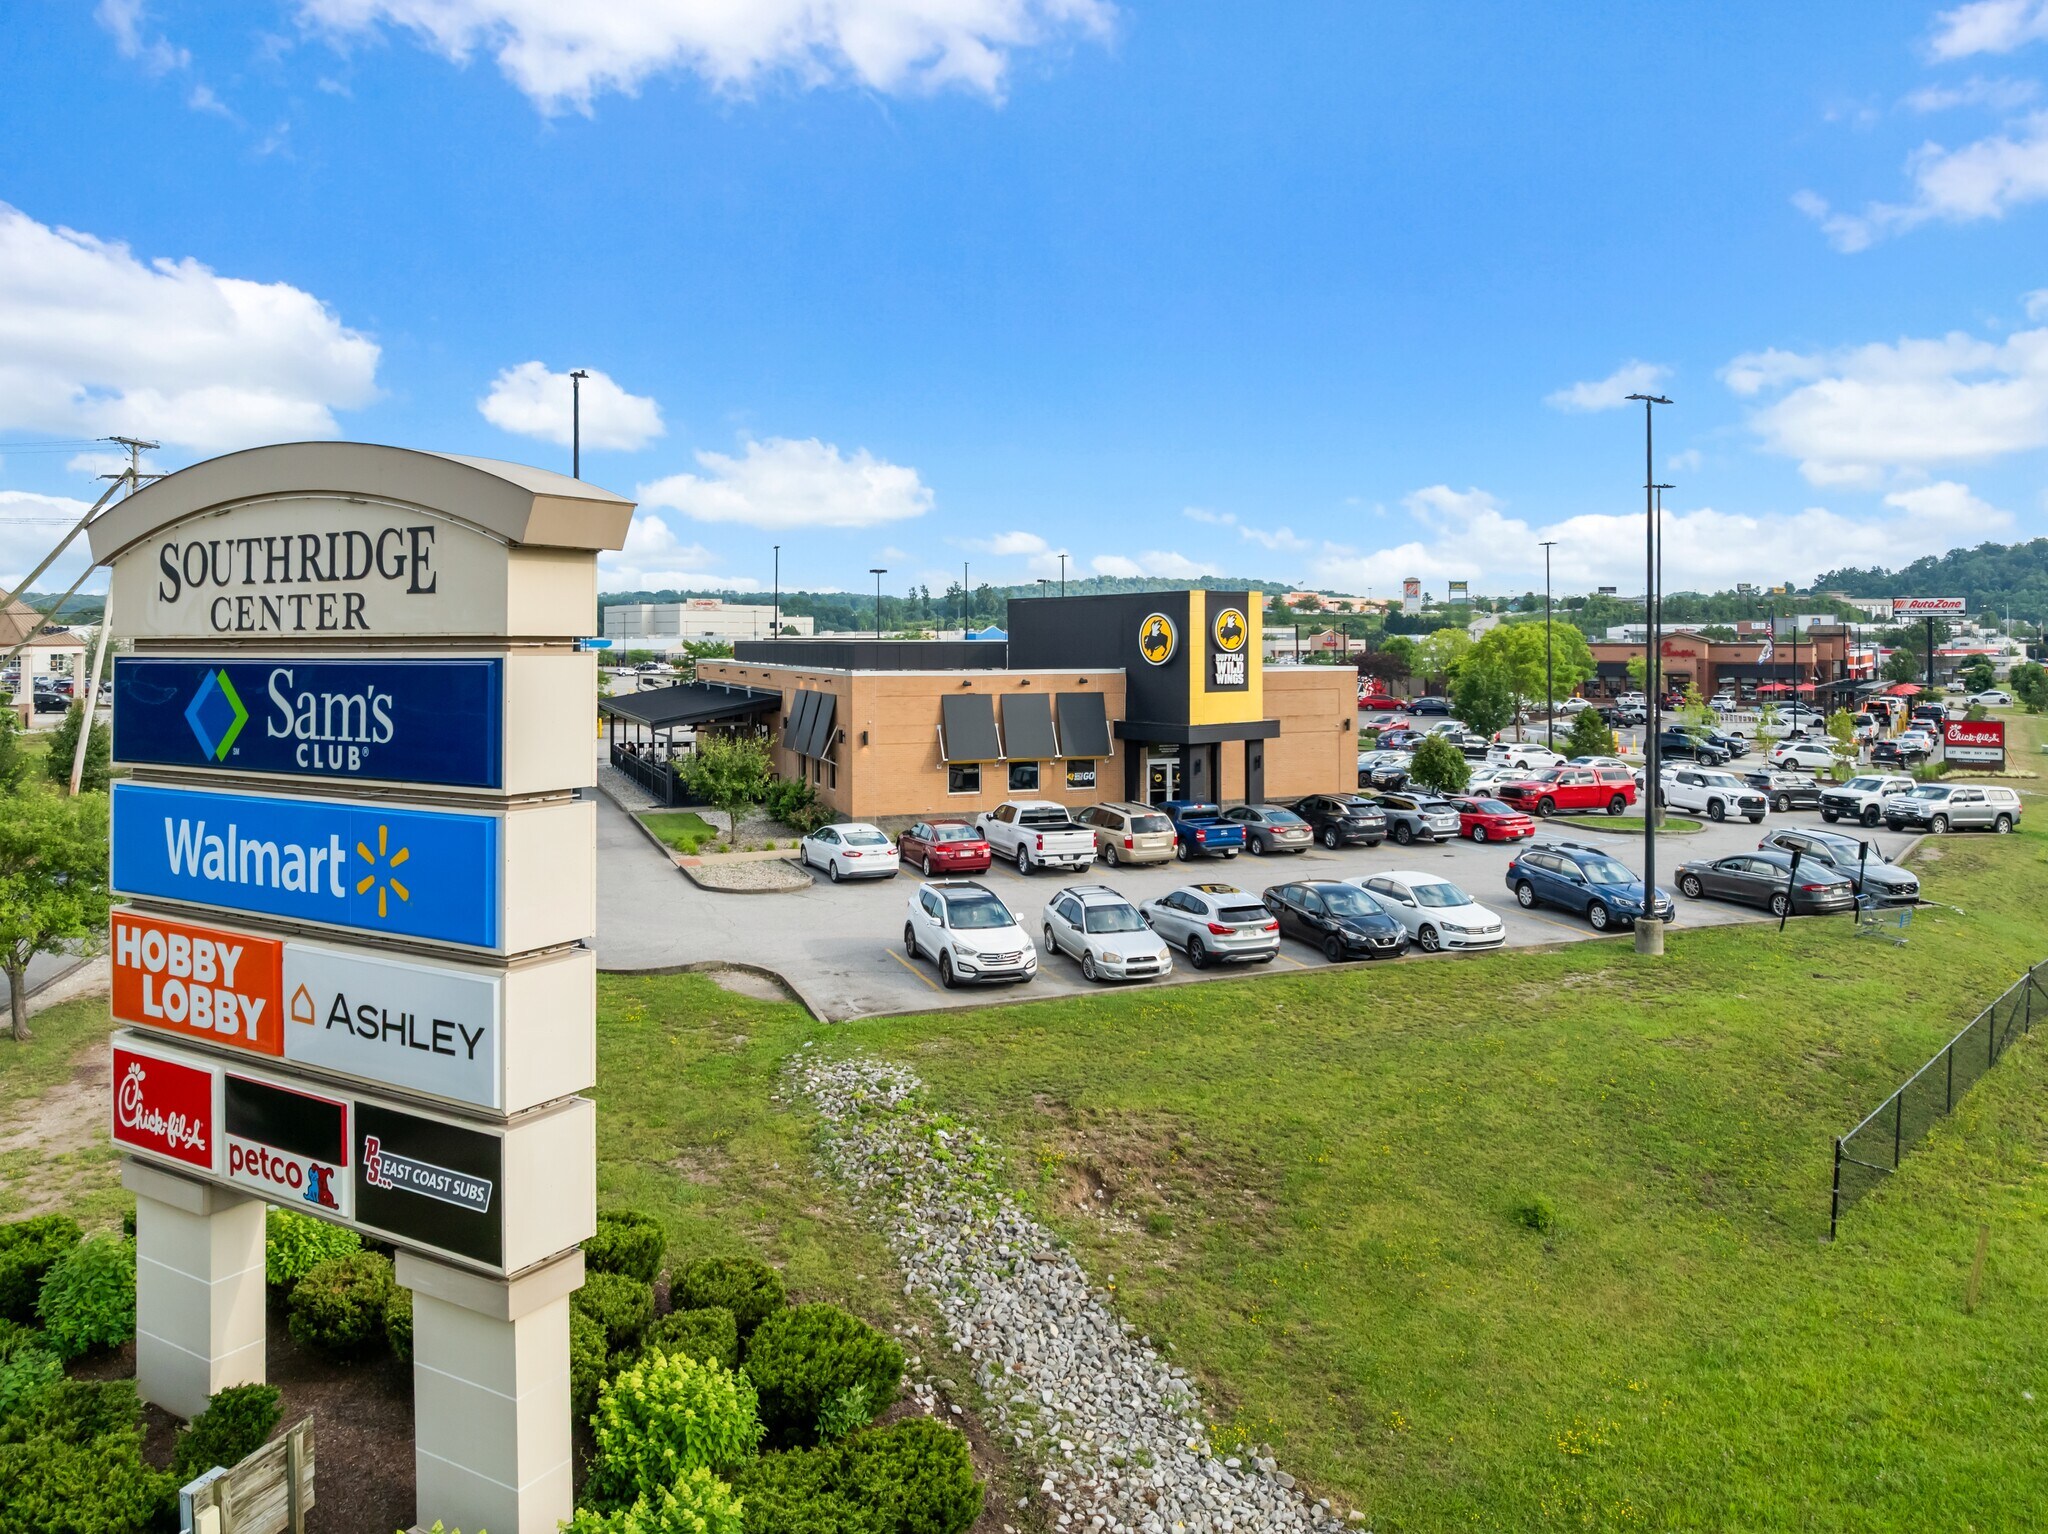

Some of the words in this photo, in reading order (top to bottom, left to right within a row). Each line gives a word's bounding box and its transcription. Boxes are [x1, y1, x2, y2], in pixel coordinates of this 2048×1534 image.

[159, 525, 437, 604] SOUTHRIDGE
[210, 592, 371, 633] CENTER
[1909, 599, 1962, 609] AutoZone
[1215, 653, 1245, 662] BUFFALO
[1215, 661, 1245, 674] WILD
[1215, 673, 1245, 685] WINGS
[267, 668, 394, 744] Sam's
[164, 817, 346, 898] Walmart
[116, 924, 244, 988] HOBBY
[143, 974, 266, 1041] LOBBY
[325, 993, 486, 1060] ASHLEY
[118, 1070, 206, 1151] Chick-fil-A
[229, 1143, 302, 1189] petco
[383, 1160, 411, 1180] EAST
[412, 1169, 452, 1192] COAST
